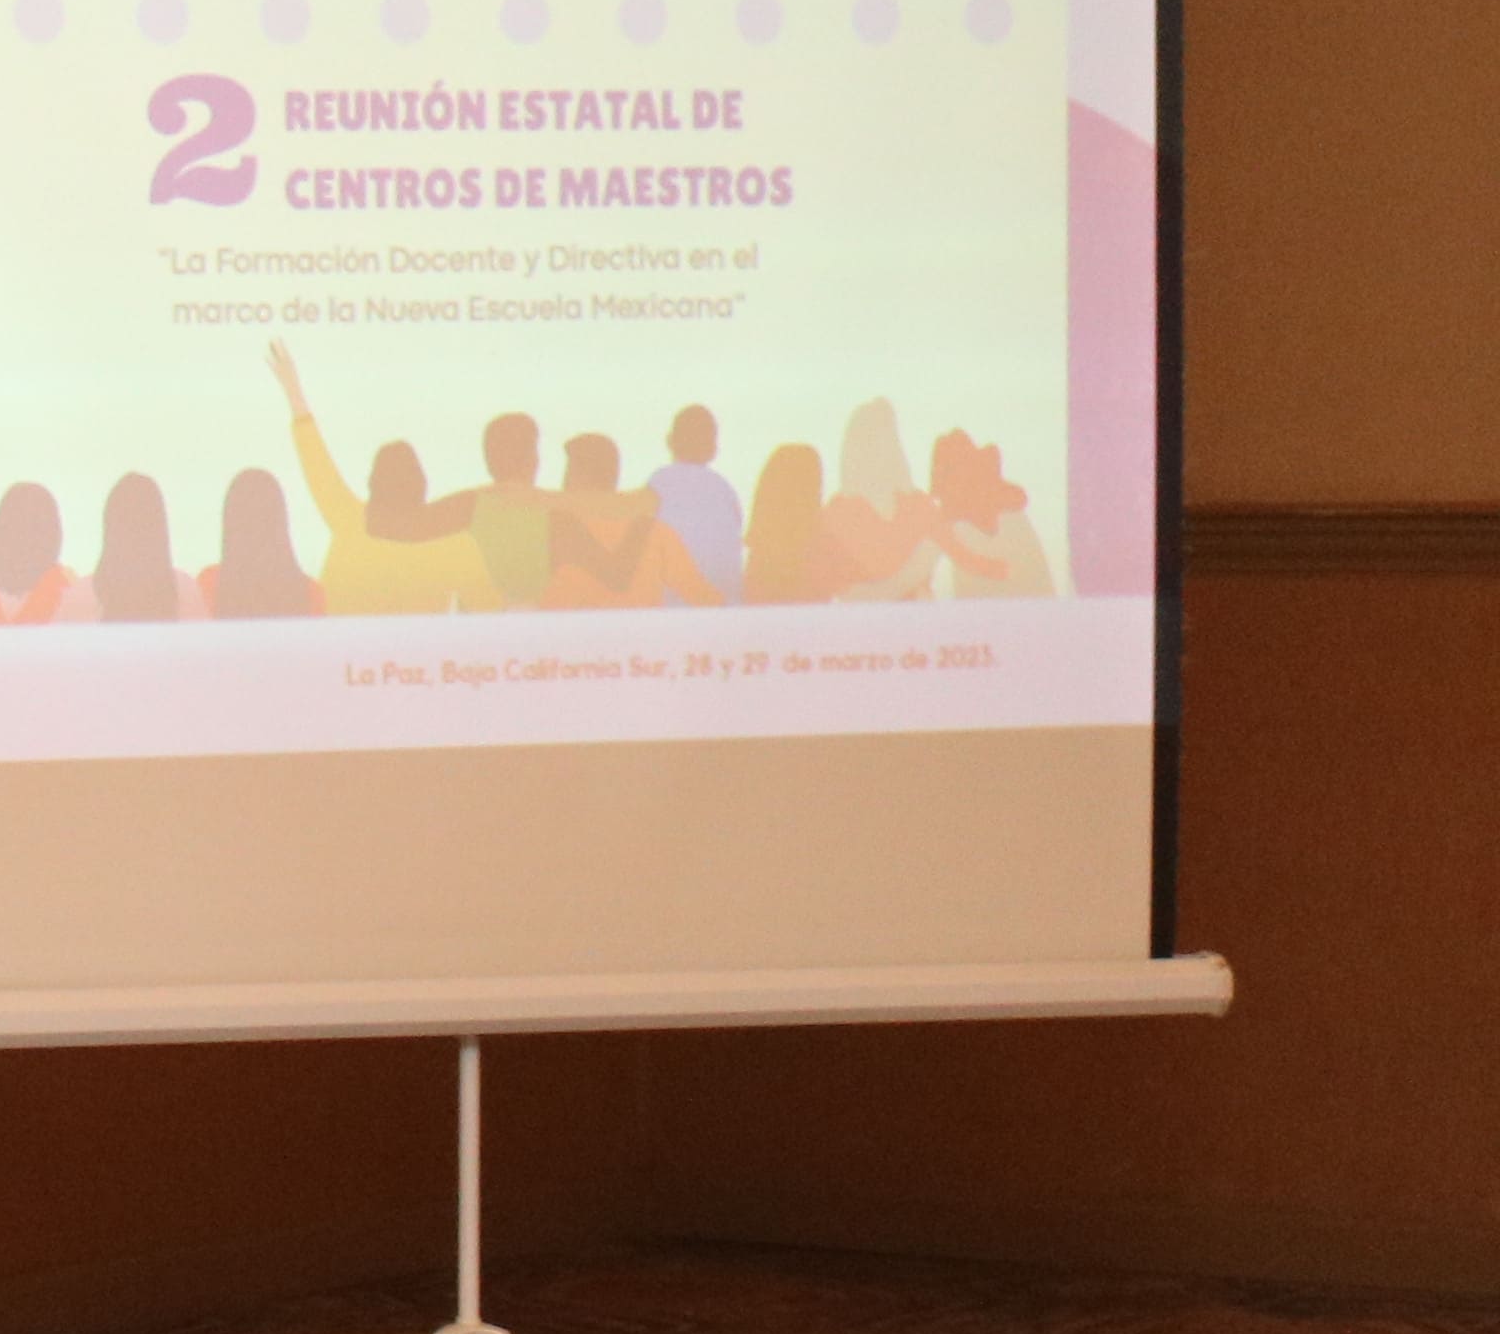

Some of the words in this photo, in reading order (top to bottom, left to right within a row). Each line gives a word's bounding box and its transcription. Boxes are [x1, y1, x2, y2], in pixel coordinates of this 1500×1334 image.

[285, 79, 487, 131] REUNIÓN
[499, 88, 681, 131] ESTATAL
[693, 88, 743, 130] DE
[147, 73, 258, 207] 2
[285, 166, 483, 210] CENTROS
[495, 166, 546, 209] DE
[559, 165, 793, 208] MAESTROS
[216, 244, 381, 274] Formación
[389, 245, 516, 273] Docente
[523, 249, 541, 279] y
[549, 243, 681, 271] Directiva
[689, 247, 726, 271] en
[734, 242, 759, 270] el
[172, 301, 274, 324] marco
[282, 295, 320, 324] de
[328, 295, 356, 323] la
[366, 296, 460, 323] Nueva
[469, 293, 582, 322] Escuela
[346, 662, 375, 687] La
[441, 658, 498, 689] Baja
[504, 655, 622, 682] California
[719, 657, 736, 682] y
[781, 650, 813, 674] de
[818, 653, 894, 673] marzo
[900, 646, 931, 671] de
